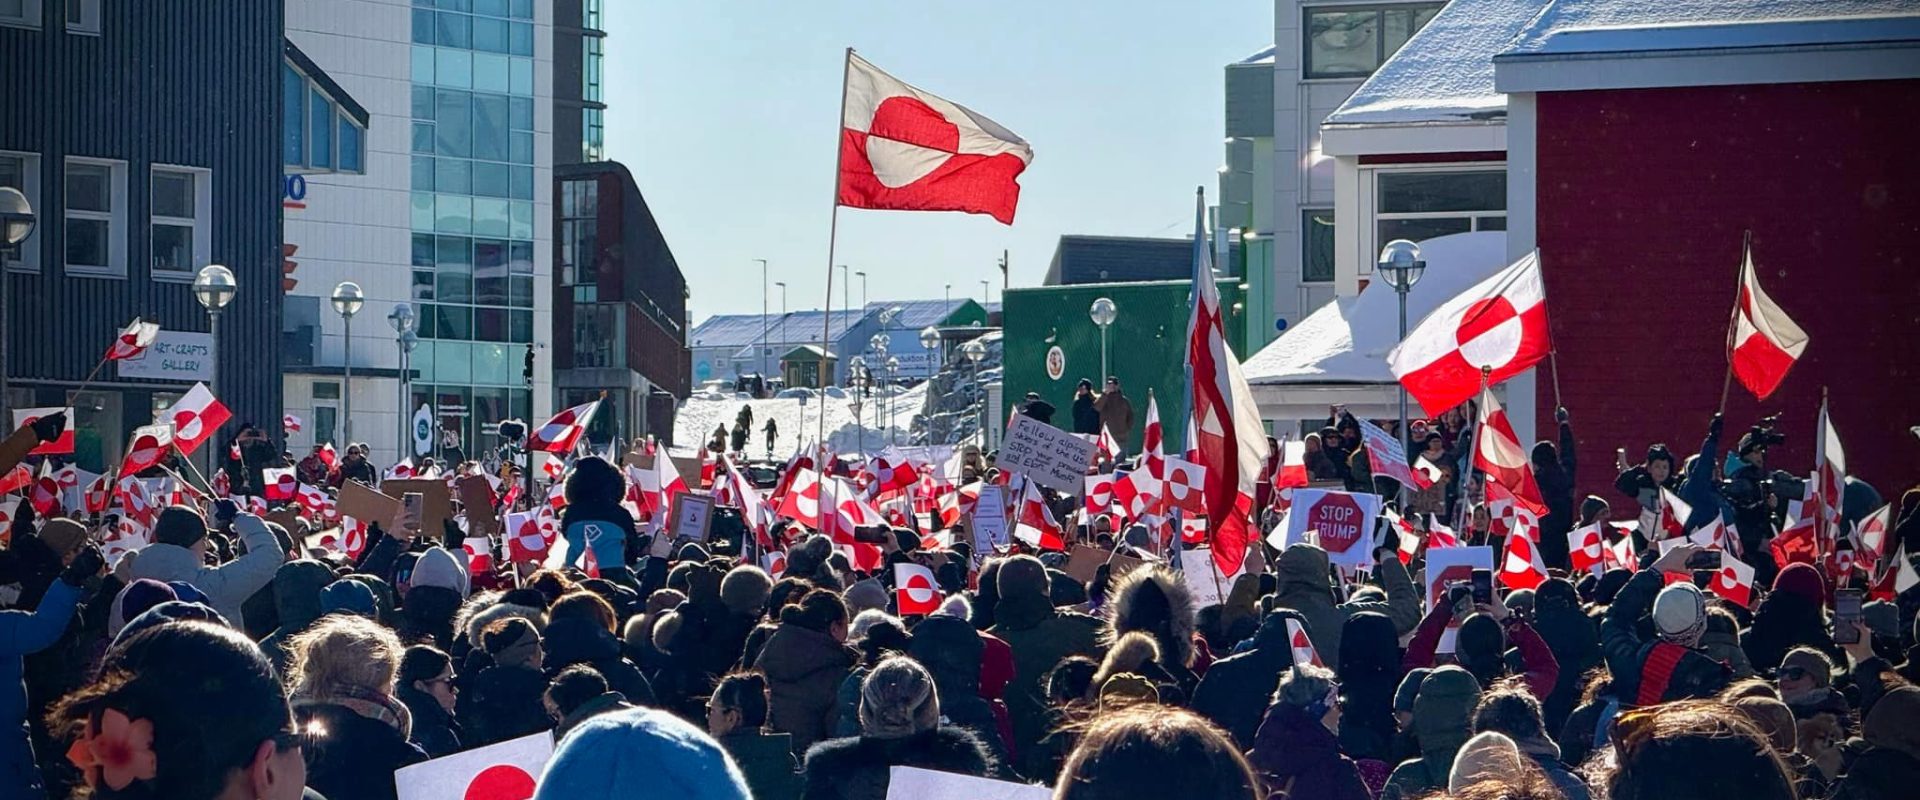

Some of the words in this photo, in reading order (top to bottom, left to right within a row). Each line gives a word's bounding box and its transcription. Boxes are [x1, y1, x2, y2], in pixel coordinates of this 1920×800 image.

[155, 342, 171, 353] ART
[176, 344, 208, 356] CRAFTS
[162, 359, 200, 372] GALLERY
[1018, 420, 1054, 442] Fellow
[1058, 439, 1087, 455] alpine
[1056, 447, 1070, 458] the
[1005, 453, 1020, 462] and
[1023, 458, 1045, 471] Elon
[1320, 505, 1353, 522] STOP
[1313, 521, 1357, 540] TRUMP
